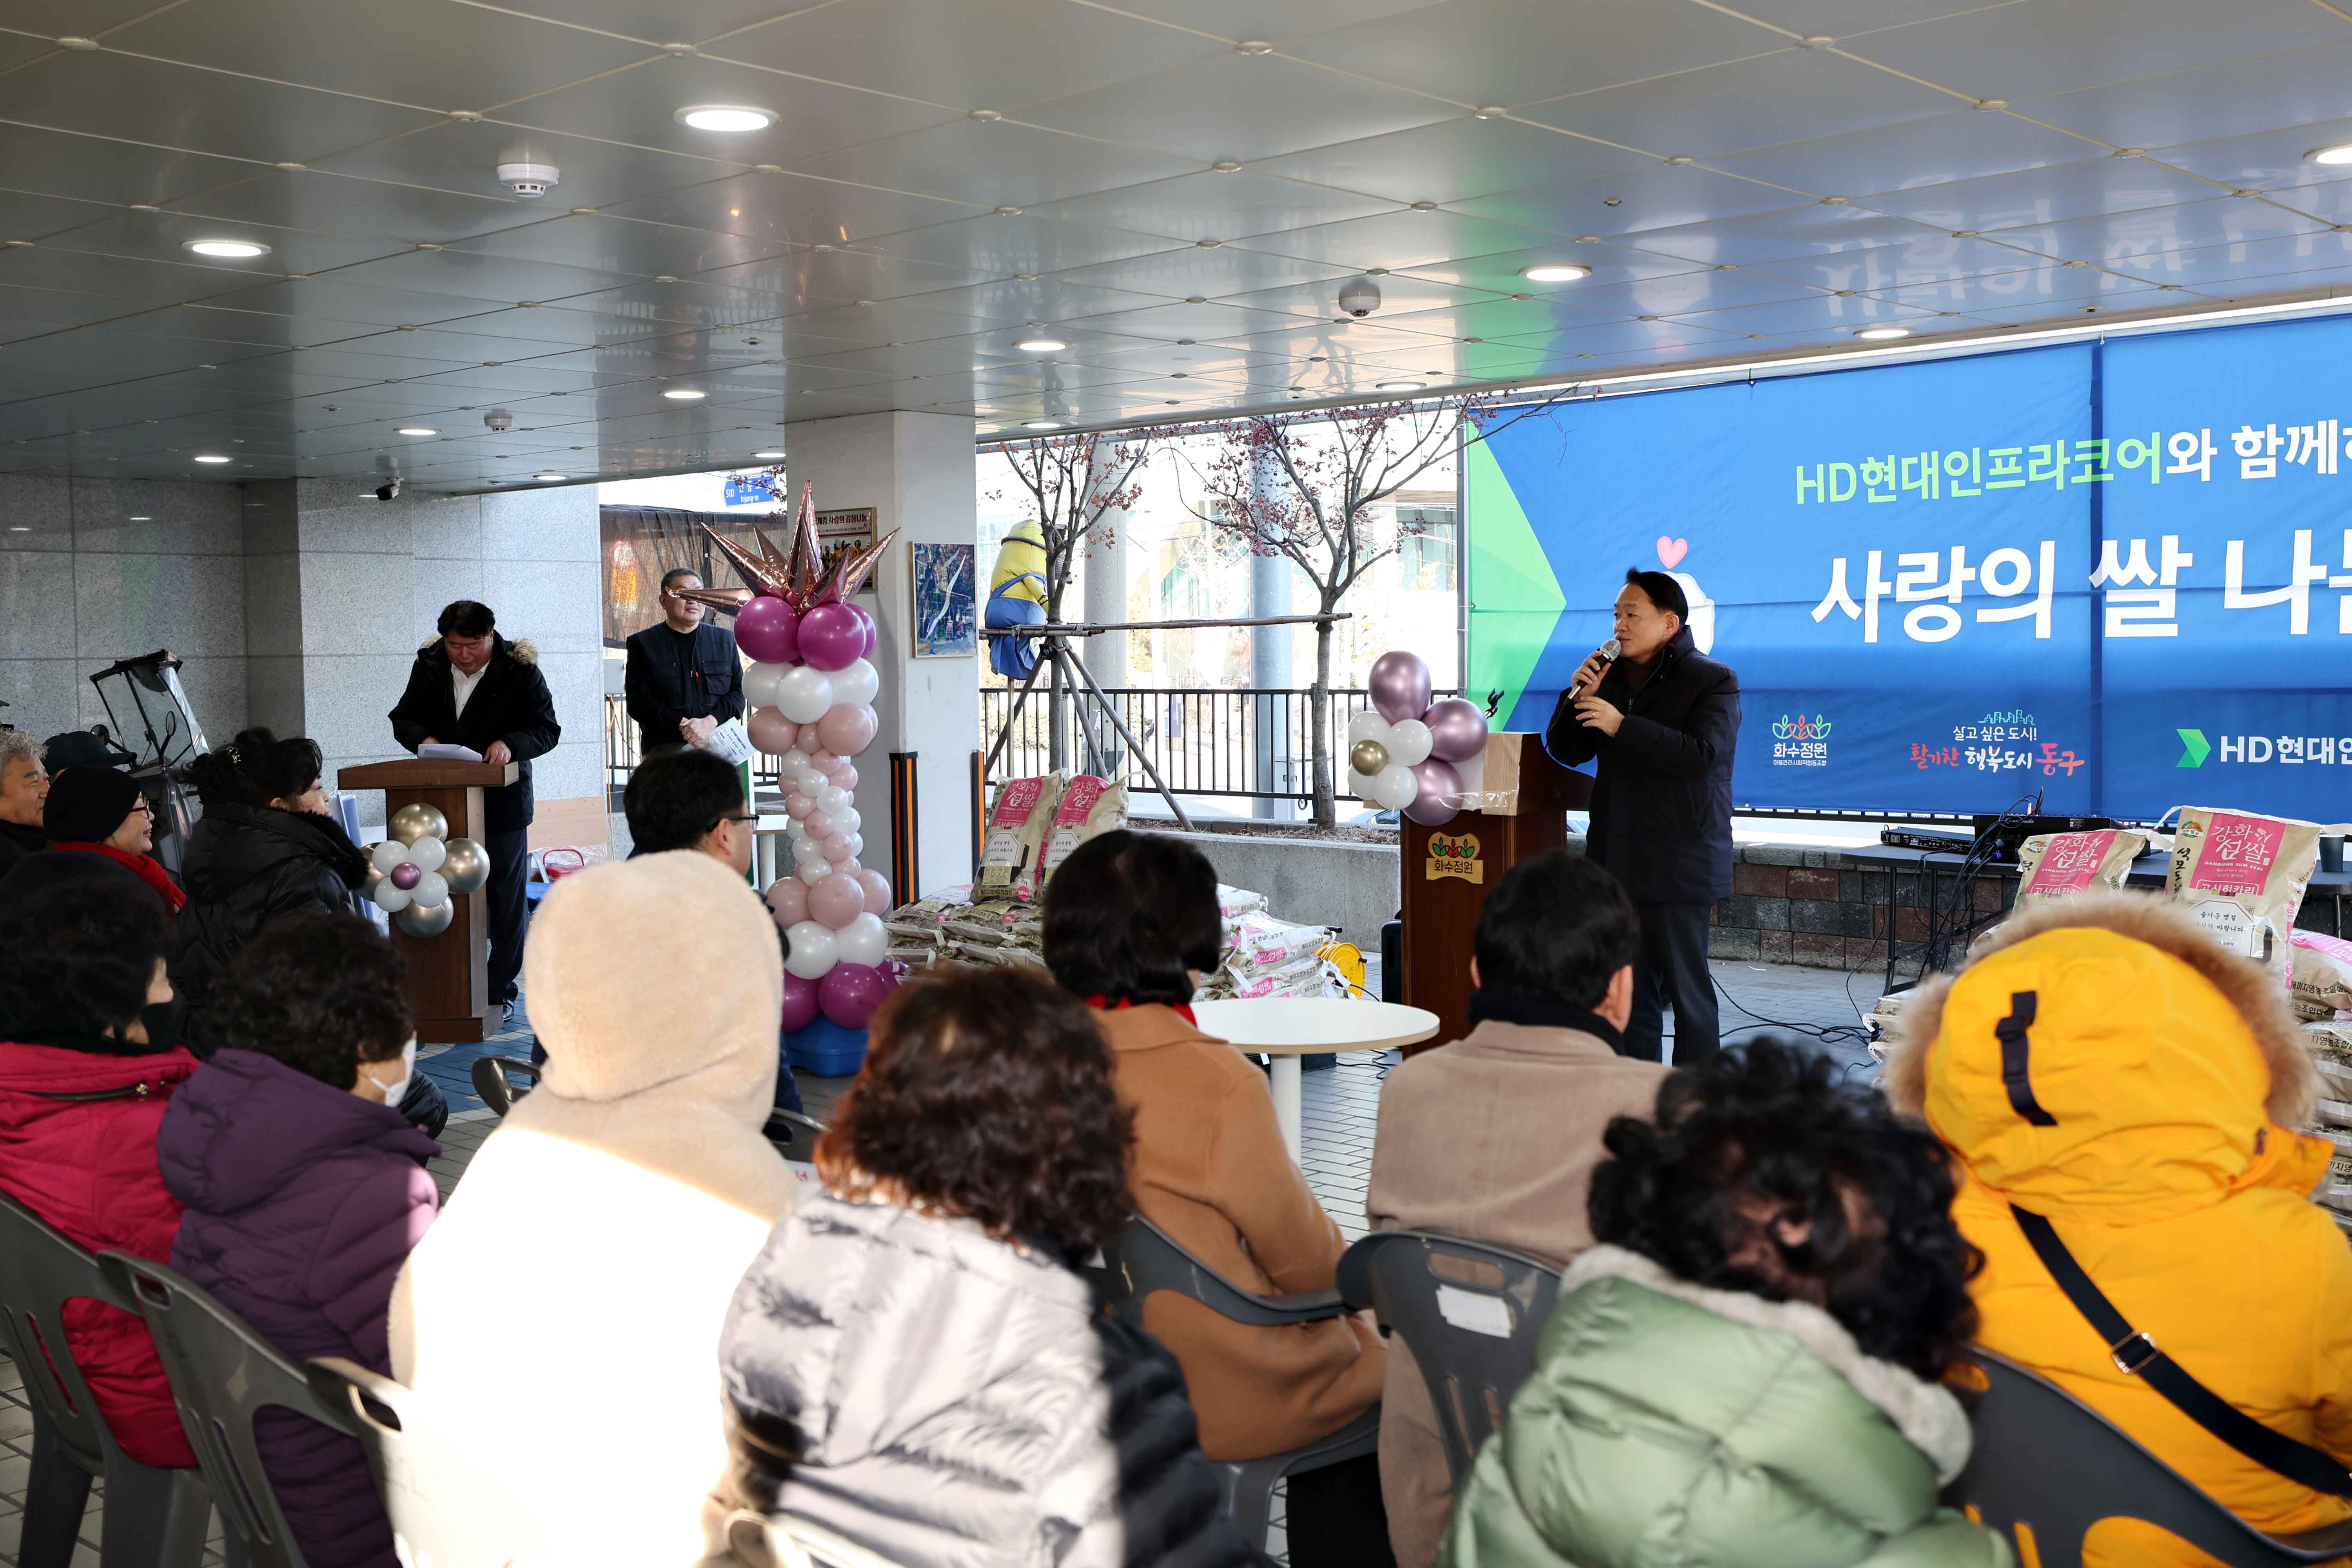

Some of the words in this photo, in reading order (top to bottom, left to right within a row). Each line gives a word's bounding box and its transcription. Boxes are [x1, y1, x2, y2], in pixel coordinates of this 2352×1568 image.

[1796, 428, 2218, 505] HD현대인프라코어와
[726, 488, 734, 498] 510
[740, 495, 759, 503] Injung-ro
[815, 516, 828, 525] 계층
[828, 515, 844, 524] 사랑의
[845, 514, 867, 523] 김장나눔
[1810, 540, 2055, 643] 사랑의
[2088, 535, 2193, 638] 쌀
[1953, 726, 1978, 740] 살고
[1980, 726, 2005, 742] 싶은
[2007, 726, 2037, 742] 도시!
[1773, 742, 1828, 759] 화수정원
[1909, 743, 1960, 769] 활기찬
[1964, 746, 2033, 773] 행복도시
[2035, 743, 2085, 776] 동구
[1009, 781, 1030, 793] 강화
[1007, 791, 1036, 807] 섬쌀
[2211, 823, 2254, 843] 강화
[2051, 836, 2089, 852] 강화
[2215, 839, 2269, 864] 섬쌀
[1434, 859, 1474, 874] 화수정원
[2052, 849, 2098, 868] 섬쌀
[2201, 884, 2255, 895] 고시히카리
[2200, 911, 2220, 920] 즐거운
[2217, 924, 2246, 934] 바랍니다.
